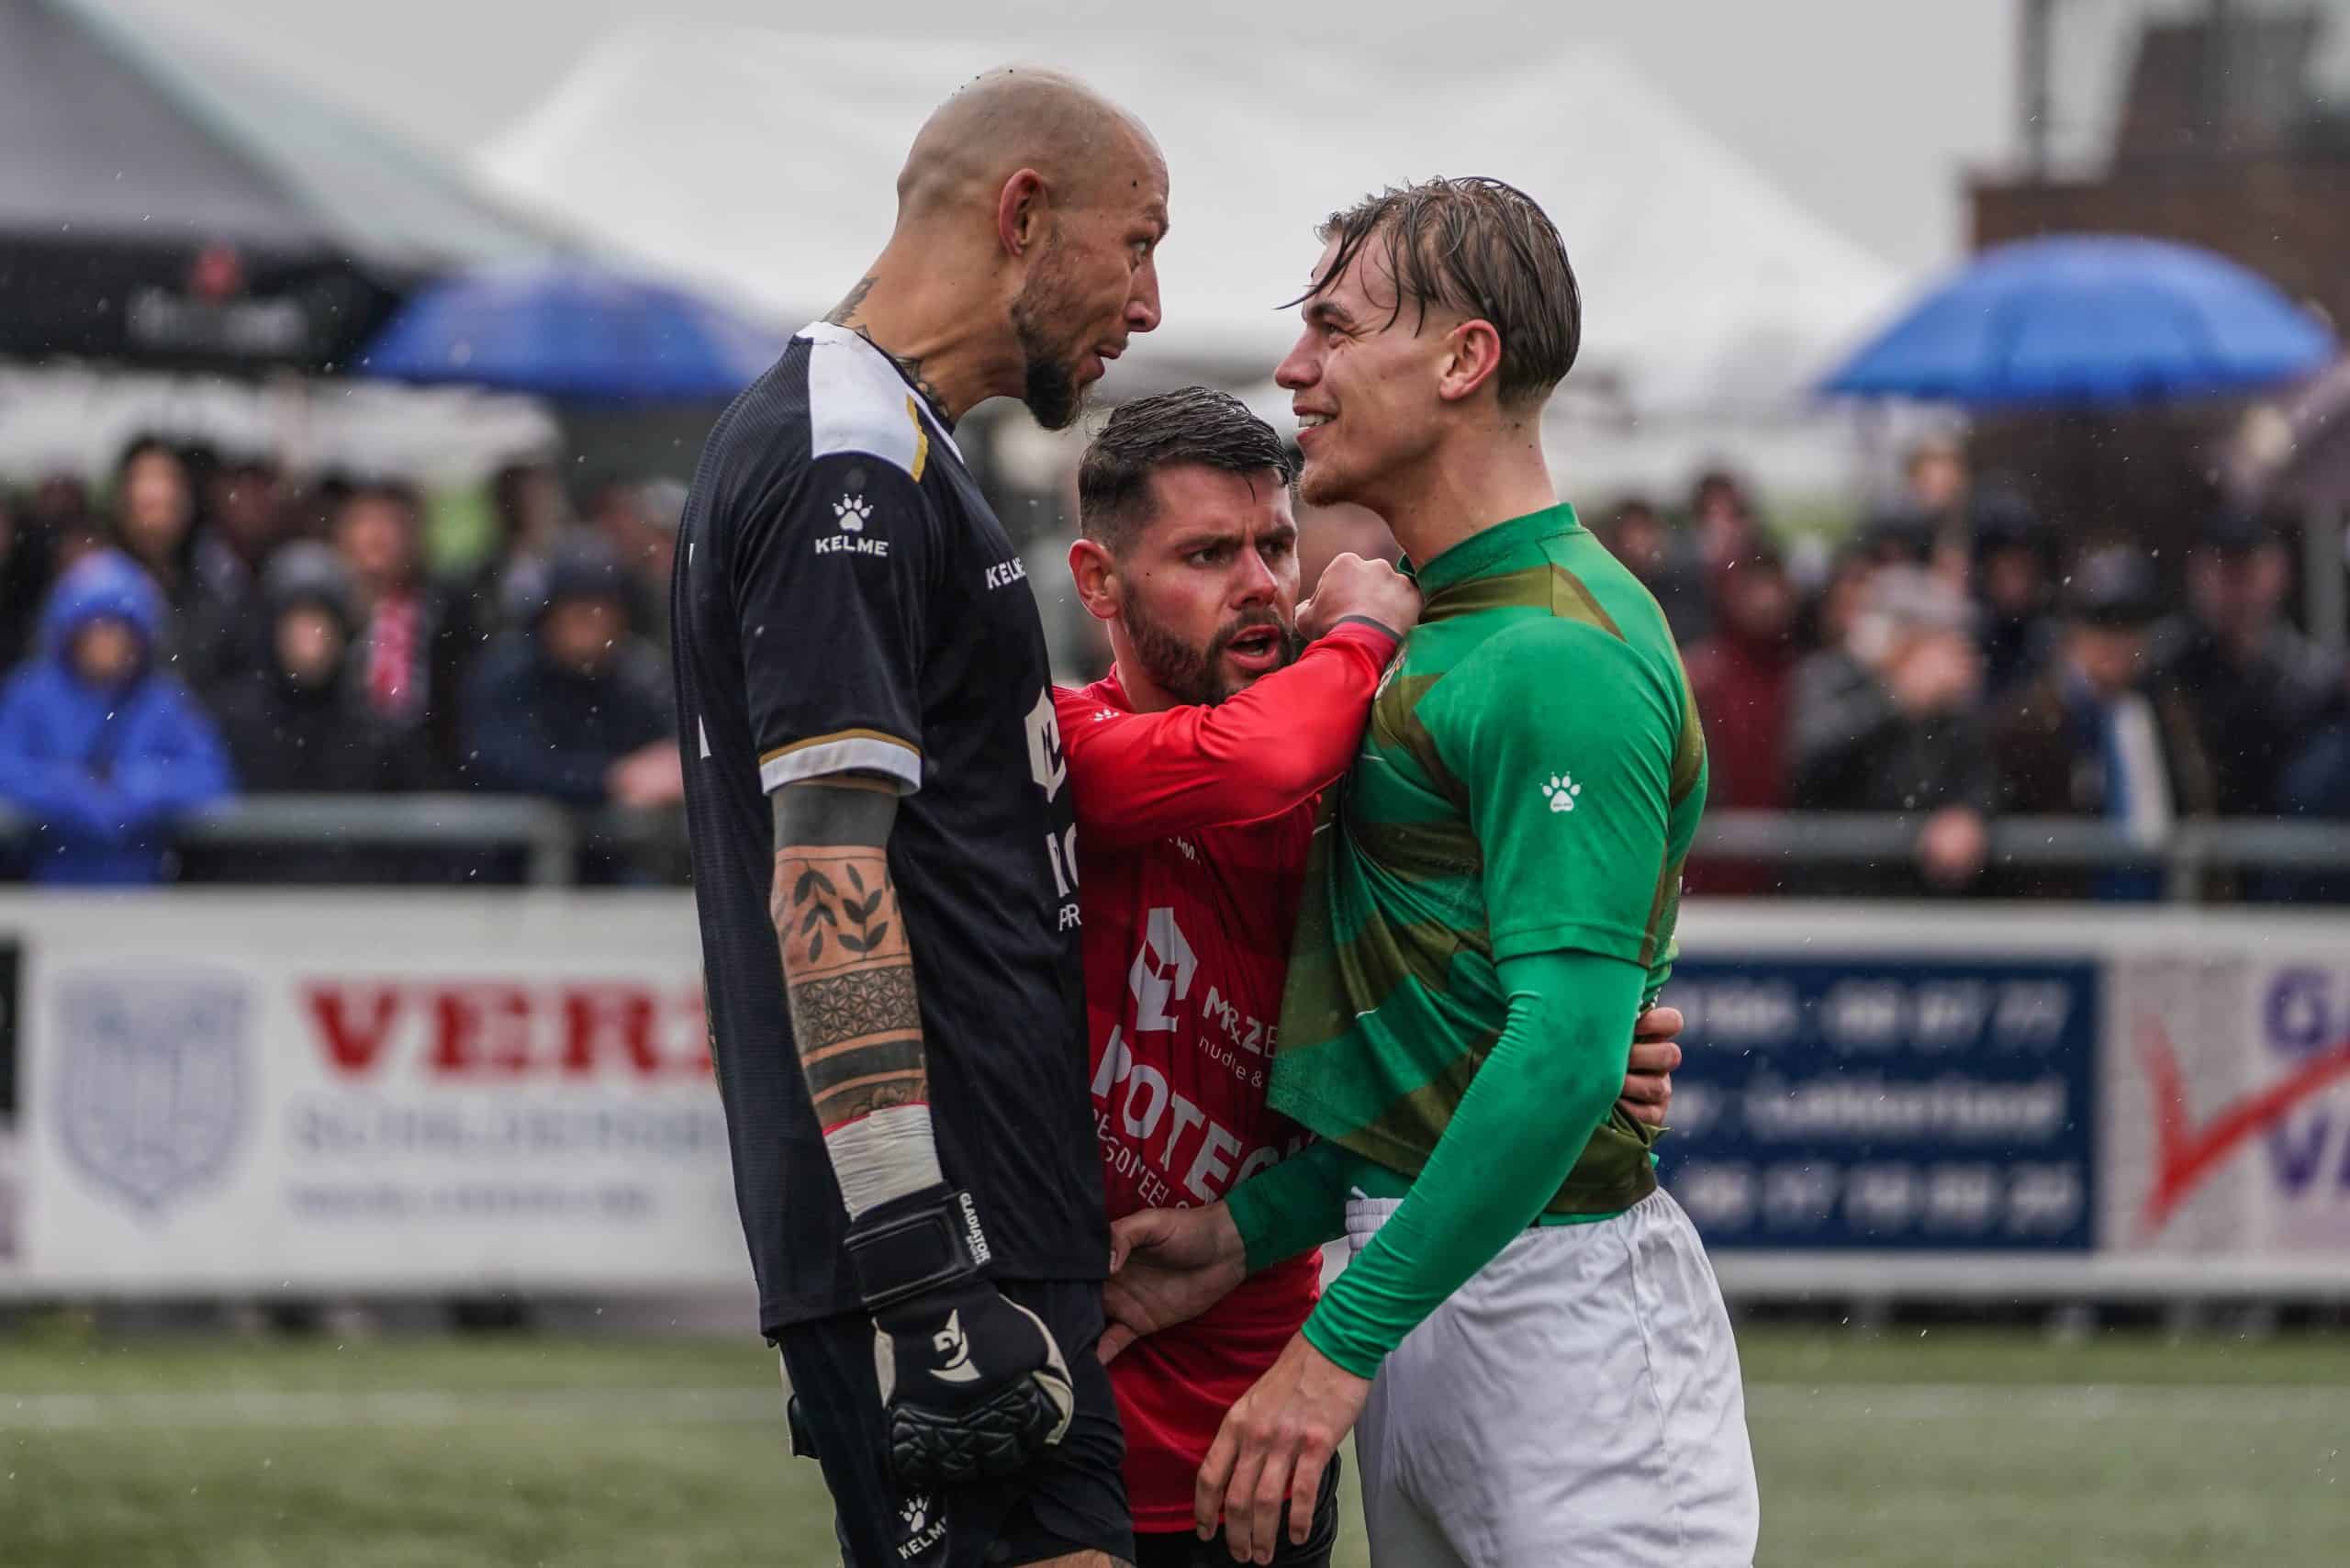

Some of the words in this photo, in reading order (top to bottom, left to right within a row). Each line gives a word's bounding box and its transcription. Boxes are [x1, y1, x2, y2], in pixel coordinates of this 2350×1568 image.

[815, 534, 890, 557] KELME
[1251, 1070, 1263, 1088] &
[959, 1193, 991, 1260] GLADIATOR
